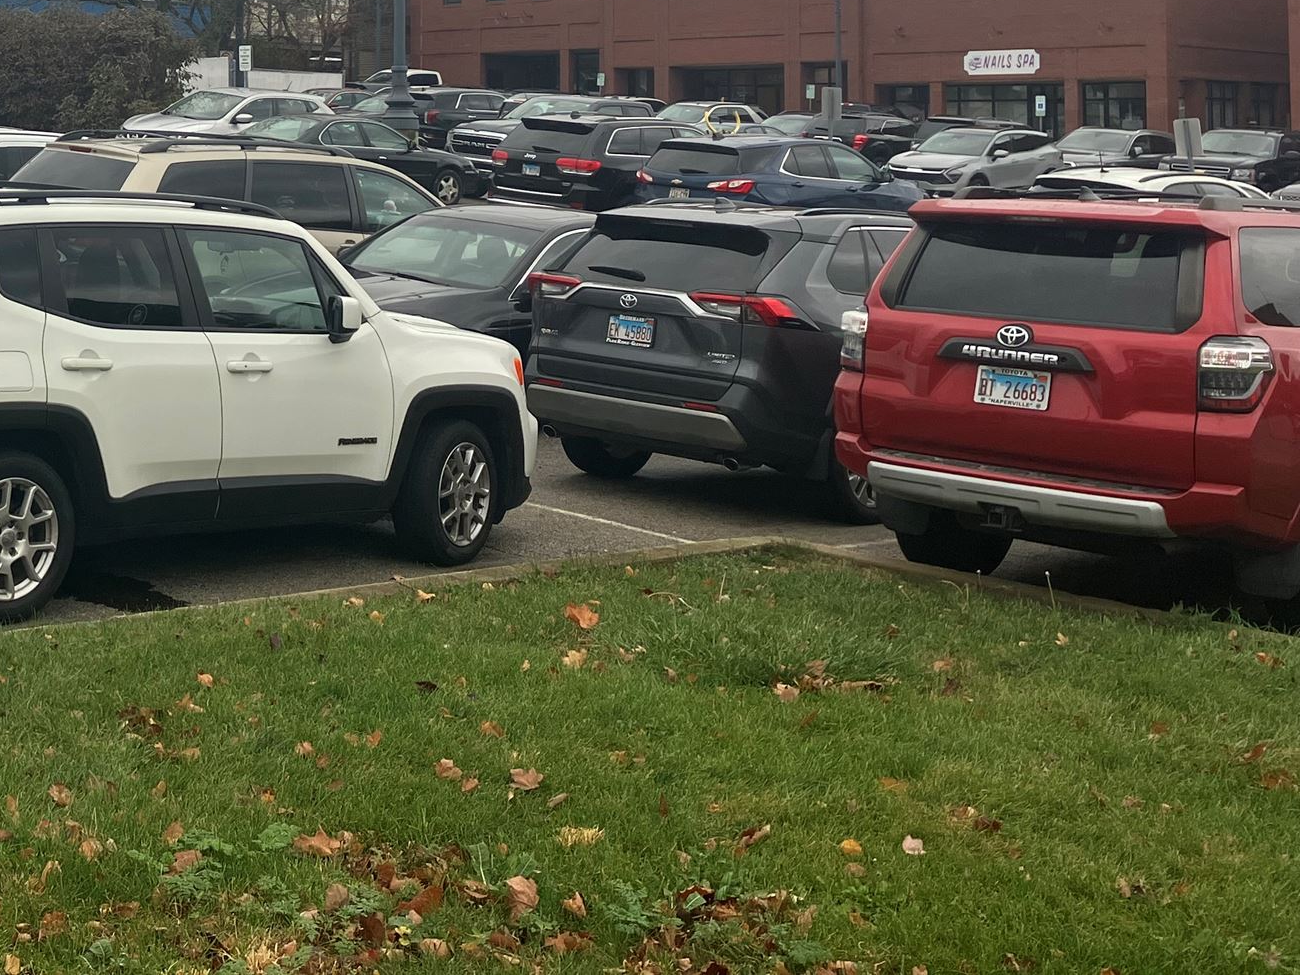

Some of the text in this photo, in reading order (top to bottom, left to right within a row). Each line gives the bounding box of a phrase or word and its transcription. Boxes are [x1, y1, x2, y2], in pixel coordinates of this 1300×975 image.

[983, 54, 1012, 69] NAILS
[1016, 53, 1035, 69] SPA
[524, 152, 537, 160] Jeep
[609, 322, 652, 342] EK 45880
[962, 344, 1059, 365] 4RUNNER
[1000, 368, 1028, 376] TOYOTA
[978, 378, 1046, 403] BT 26683
